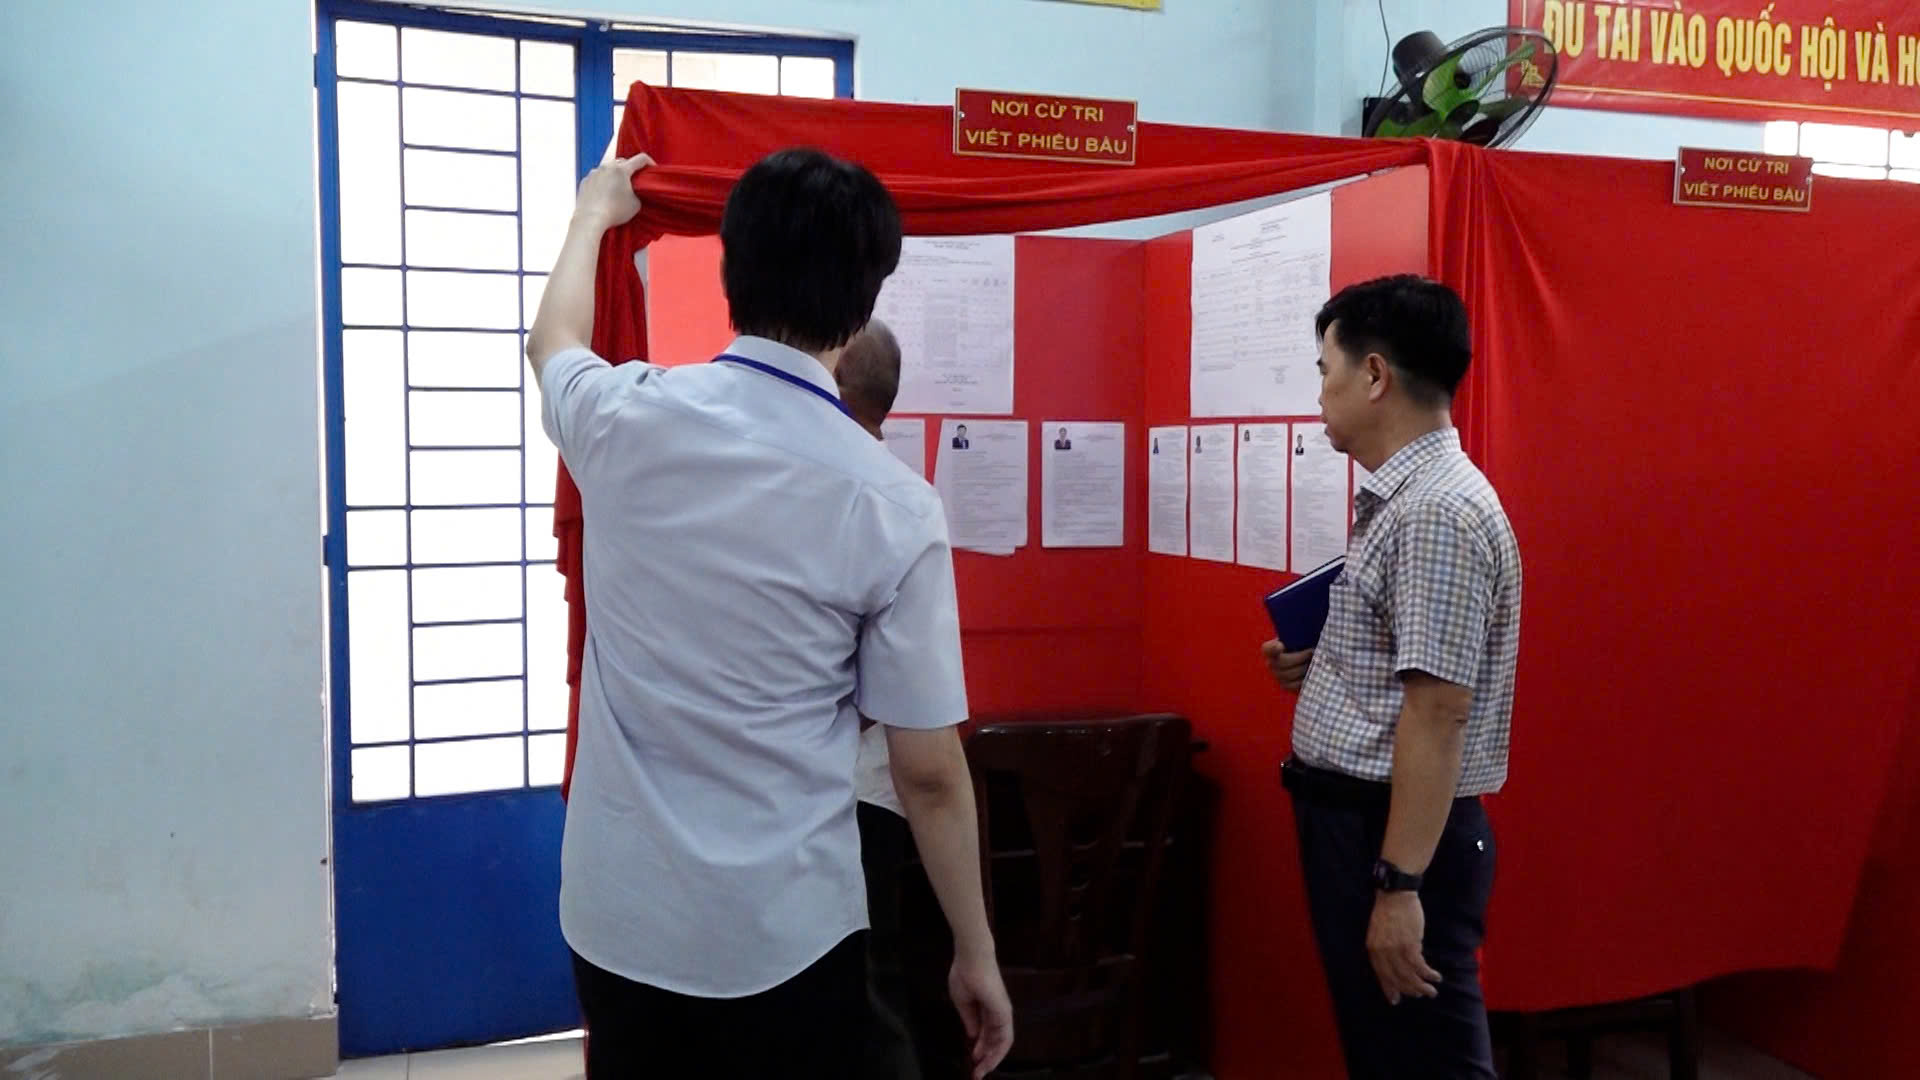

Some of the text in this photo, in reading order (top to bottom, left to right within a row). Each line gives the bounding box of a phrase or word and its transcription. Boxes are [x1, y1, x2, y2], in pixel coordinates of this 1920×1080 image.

[1651, 1, 1706, 68] VÀO
[1716, 3, 1792, 77] QUỐC
[1800, 16, 1846, 91] HỘI
[1855, 21, 1890, 84] VÀ
[1898, 35, 1920, 87] H
[991, 99, 1028, 116] NƠI
[1072, 105, 1103, 122] TRI
[1704, 157, 1733, 171] NƠI
[1765, 161, 1789, 174] TRI
